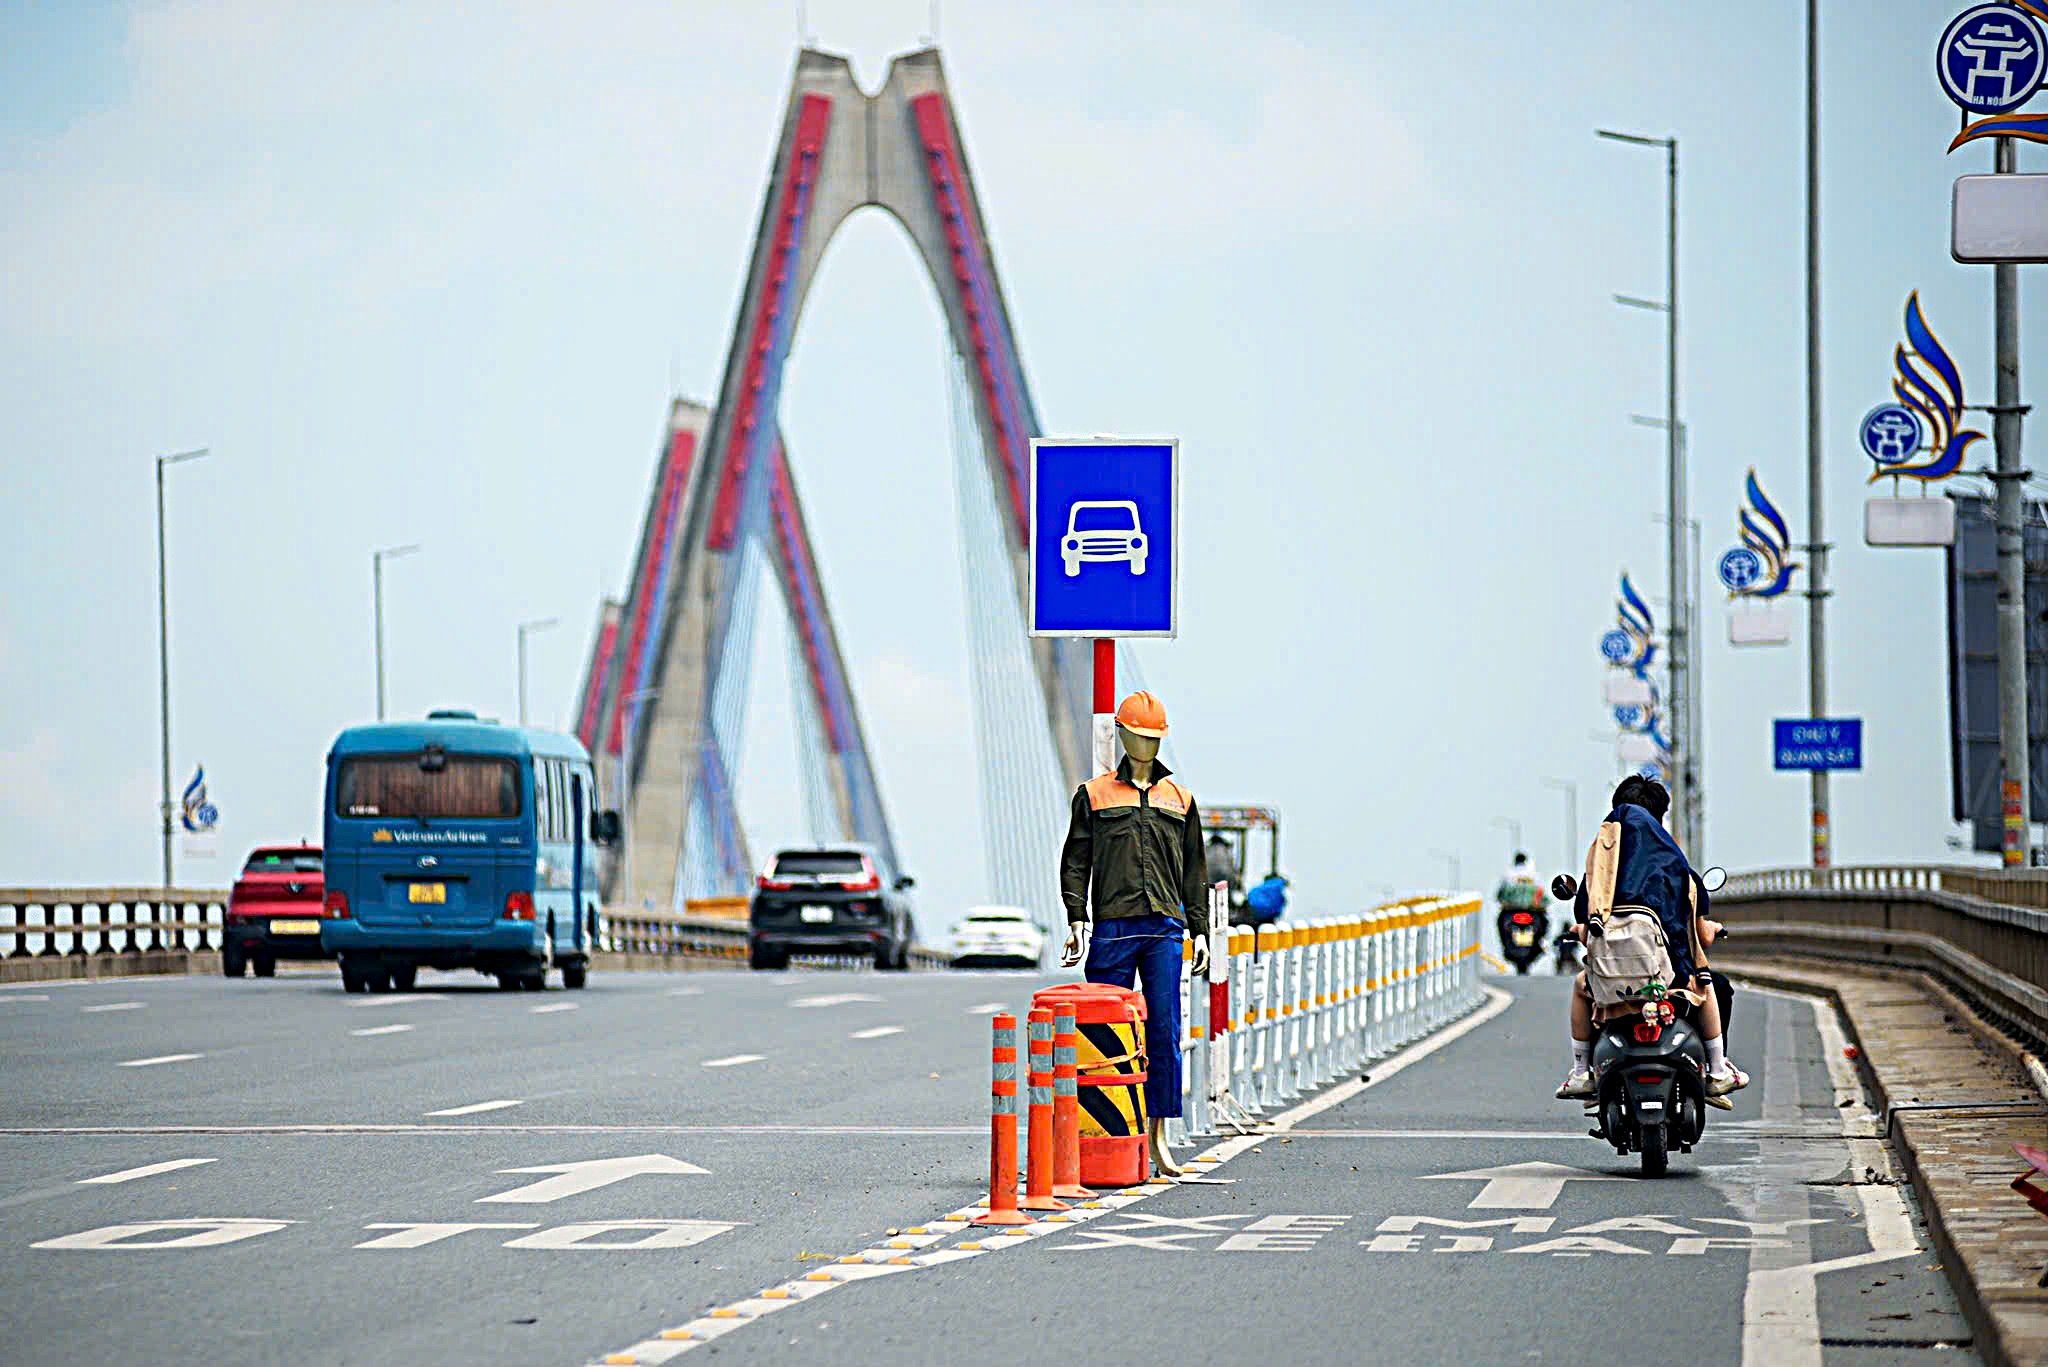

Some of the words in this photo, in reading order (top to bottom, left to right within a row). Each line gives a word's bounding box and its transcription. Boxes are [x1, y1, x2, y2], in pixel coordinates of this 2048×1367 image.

[394, 829, 441, 844] Vietnam
[1093, 1213, 1353, 1231] XE
[1048, 1232, 1324, 1251] XE
